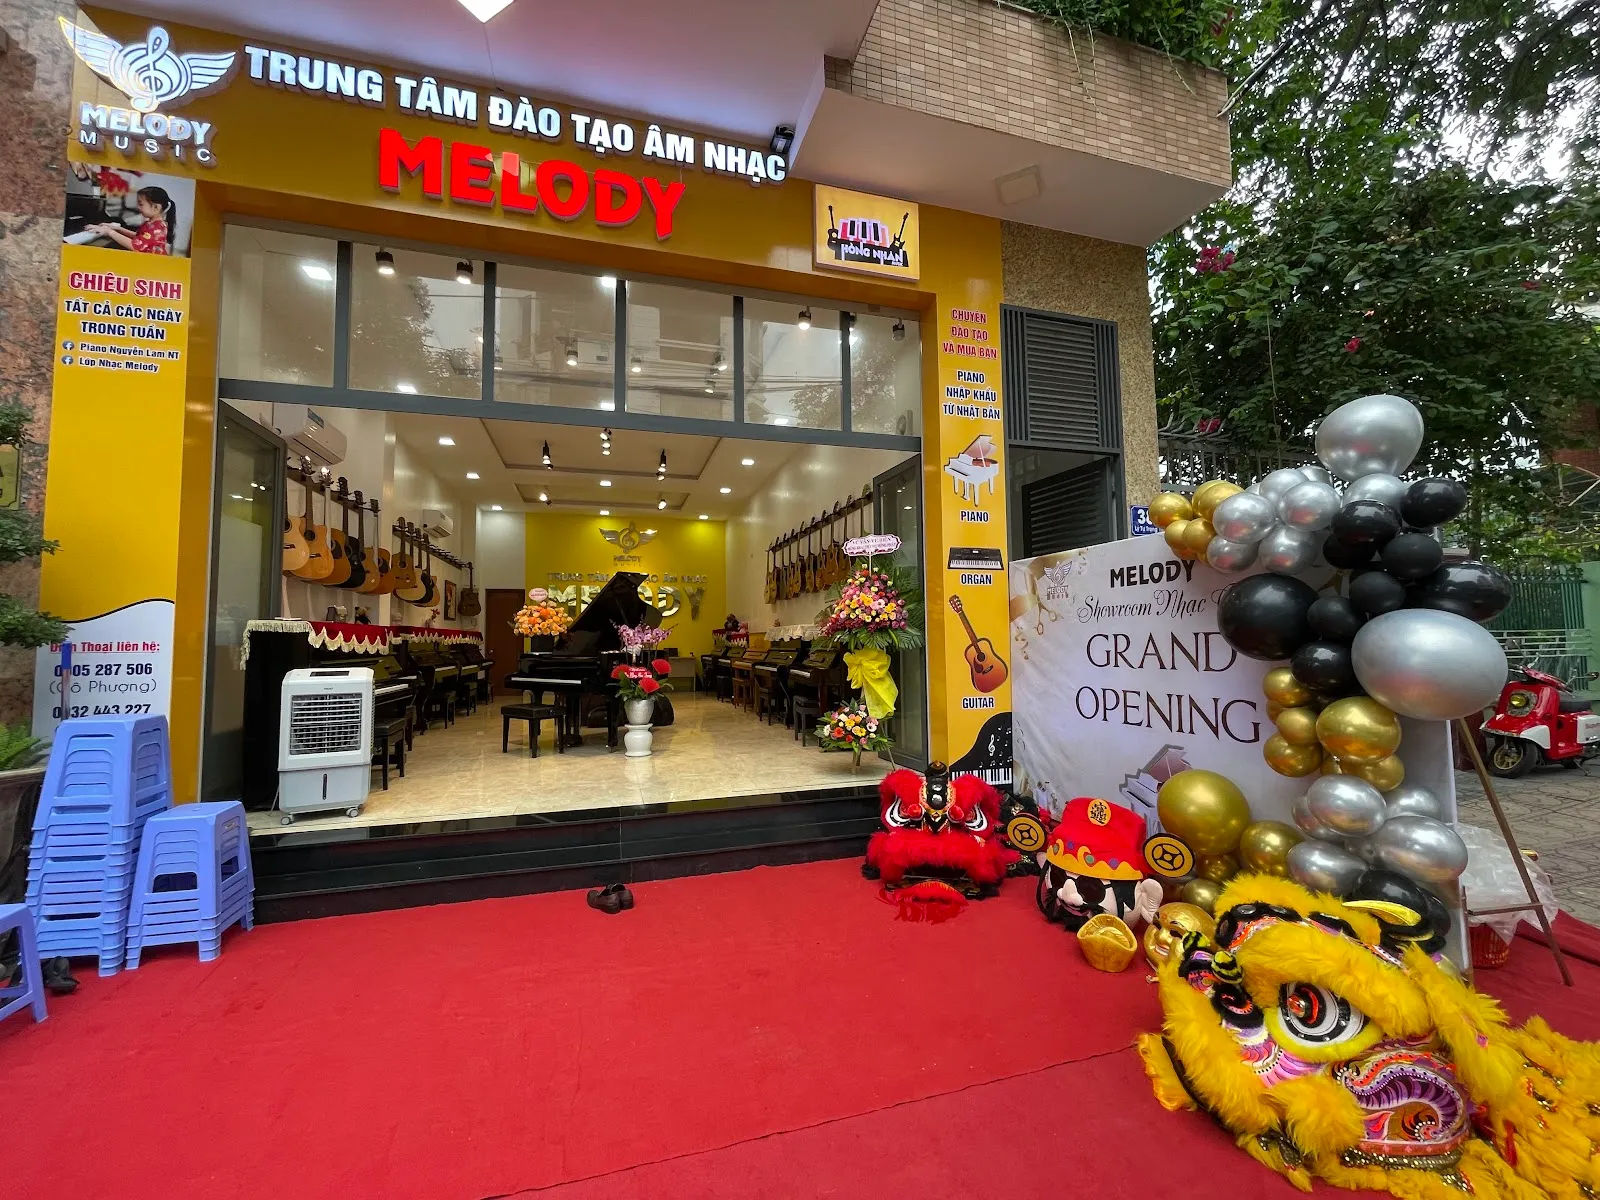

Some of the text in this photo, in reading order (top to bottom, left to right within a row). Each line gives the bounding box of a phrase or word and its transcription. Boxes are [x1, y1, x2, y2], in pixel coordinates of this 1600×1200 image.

[245, 45, 787, 184] TRUNG TÂM ĐÀO TẠO ÂM NHẠC
[80, 101, 212, 146] MELODY
[81, 130, 212, 162] MUSIC
[379, 128, 687, 241] MELODY
[69, 271, 182, 300] CHIÊU SINH
[65, 297, 182, 322] TẤT CẢ CÁC NGÀY
[952, 309, 987, 324] CHUYÊN
[81, 321, 126, 336] TRONG
[80, 343, 107, 353] Piano
[146, 350, 165, 358] Lam
[943, 341, 955, 354] VÀ
[957, 344, 976, 357] MUA
[98, 359, 122, 369] Nhạc
[125, 362, 159, 373] Melody
[957, 370, 985, 384] PIANO
[946, 386, 971, 401] NHẬP
[956, 404, 980, 419] NHẬT
[960, 510, 989, 523] PIANO
[960, 573, 992, 585] ORGAN
[1110, 559, 1196, 588] MELODY
[1077, 594, 1153, 624] Showroom
[1153, 589, 1207, 621] Nhạc
[81, 641, 113, 653] Thoại
[117, 641, 139, 652] liên
[143, 641, 160, 653] hệ:
[1086, 631, 1238, 673] GRAND
[54, 663, 153, 677] 005 287 506
[89, 678, 157, 694] Phượng)
[962, 697, 995, 710] GUITAR
[53, 705, 89, 719] 032
[1075, 686, 1261, 743] OPENING
